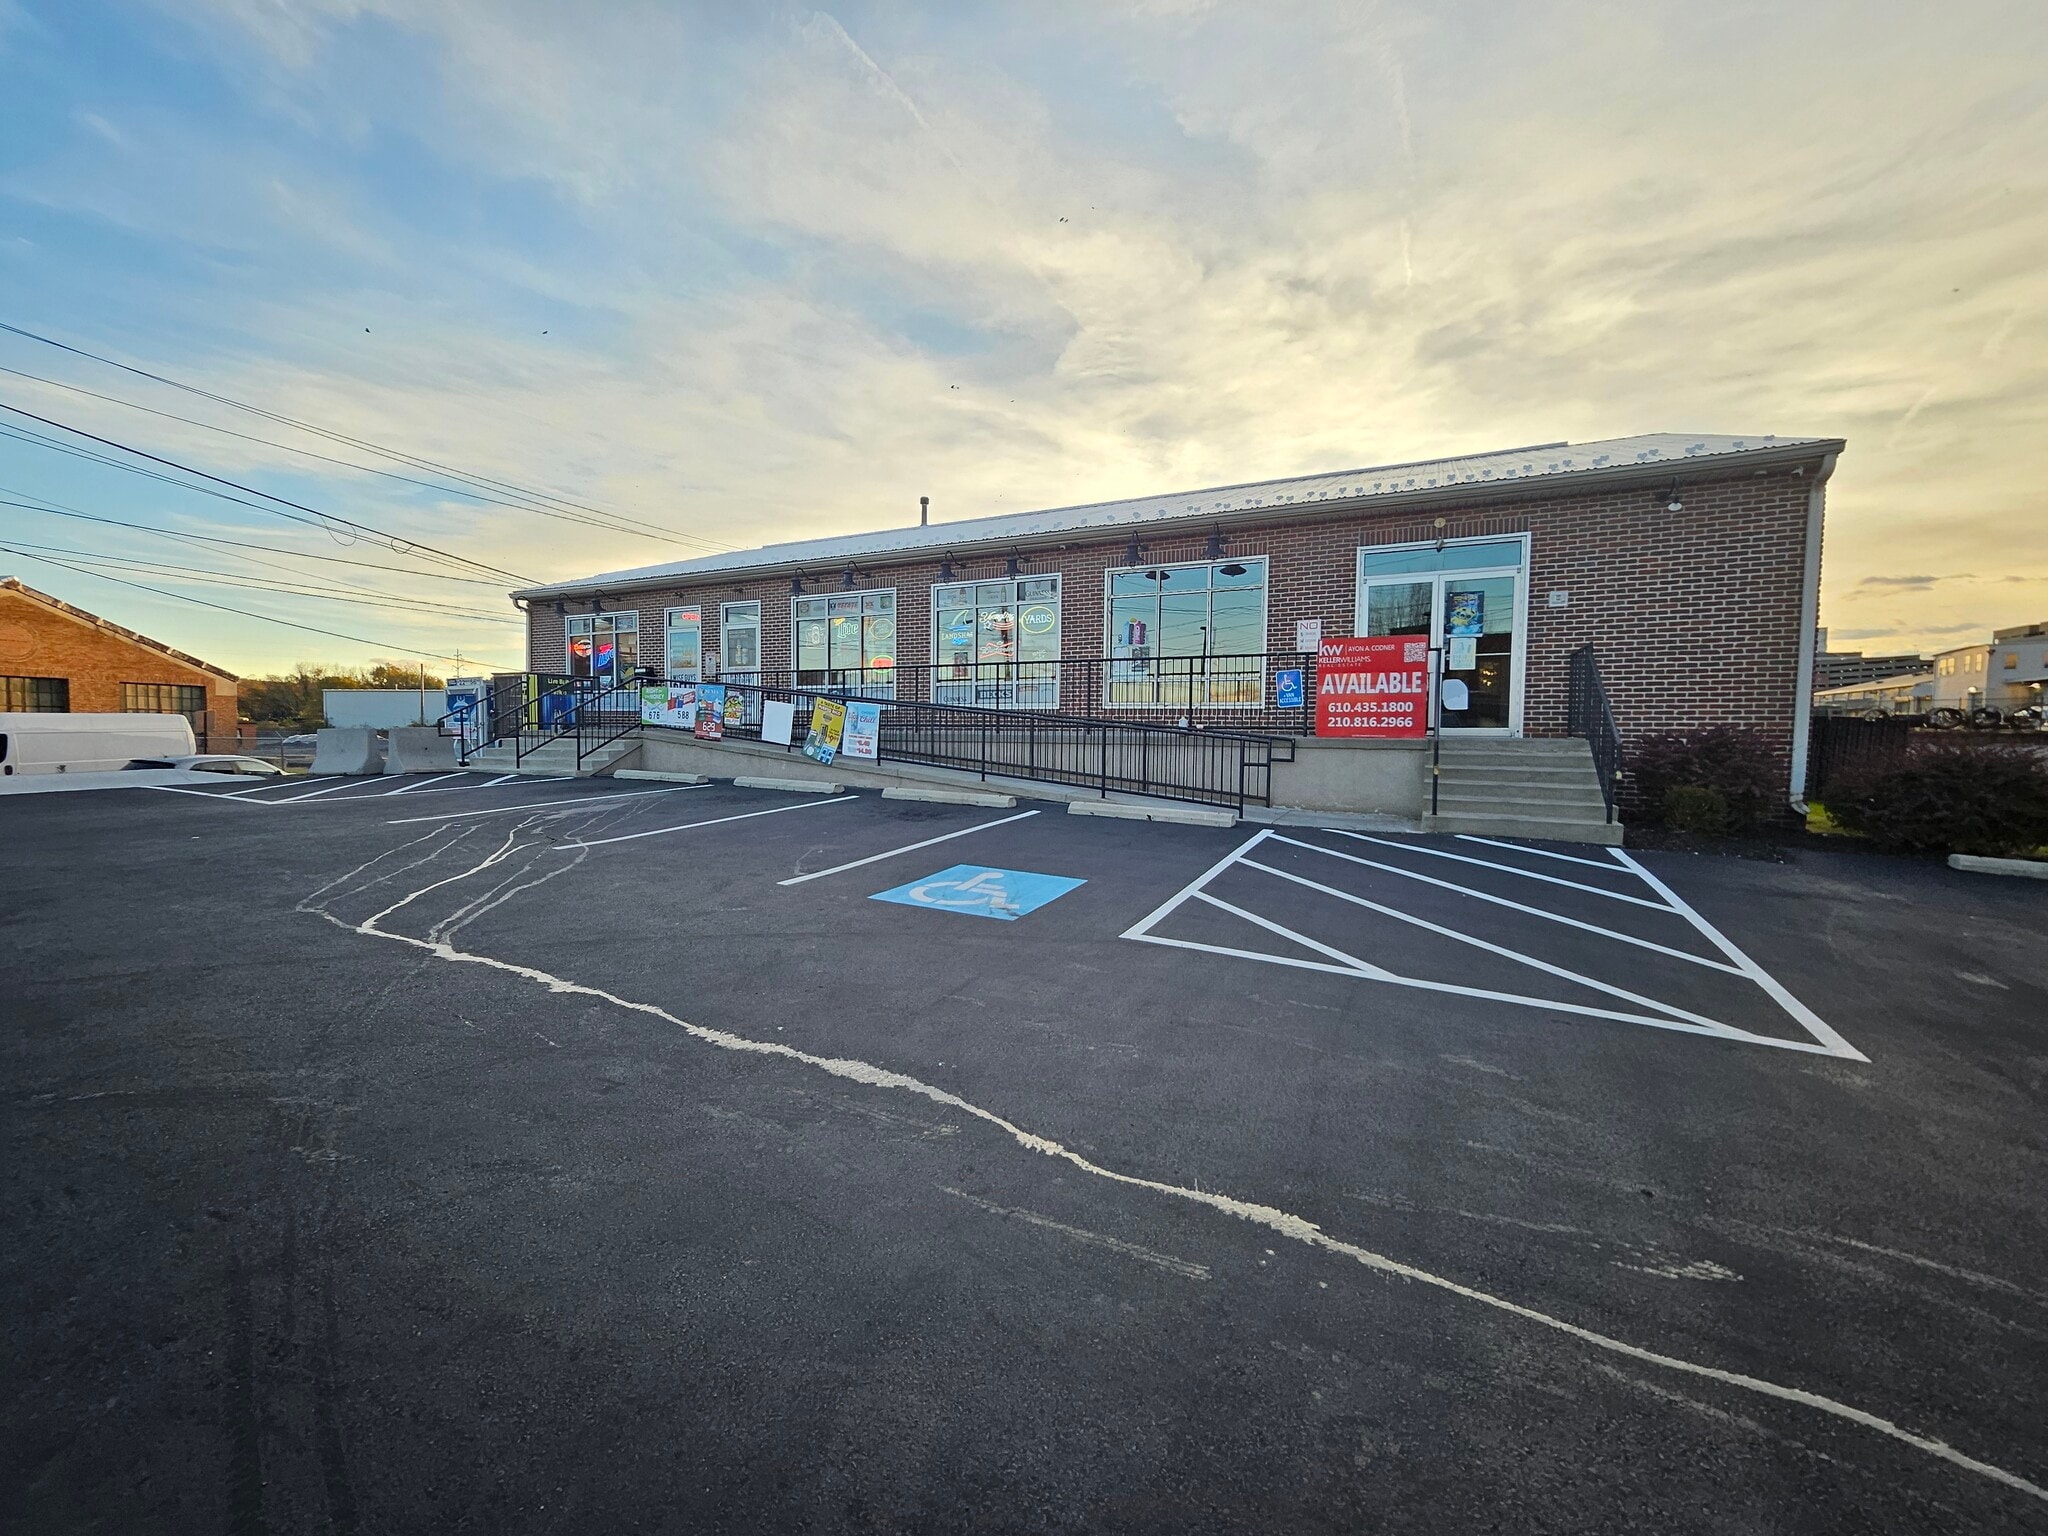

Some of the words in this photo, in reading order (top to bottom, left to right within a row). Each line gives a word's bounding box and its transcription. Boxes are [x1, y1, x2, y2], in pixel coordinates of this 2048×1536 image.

[1024, 614, 1053, 624] YARDS
[837, 622, 859, 638] Lite
[1300, 622, 1318, 630] NO
[1371, 644, 1395, 652] CODNER
[1321, 671, 1422, 694] AVAILABLE
[1328, 701, 1413, 713] 610.435.1800
[677, 710, 690, 720] 588
[702, 721, 716, 732] 629
[1328, 716, 1413, 728] 210.816.2966
